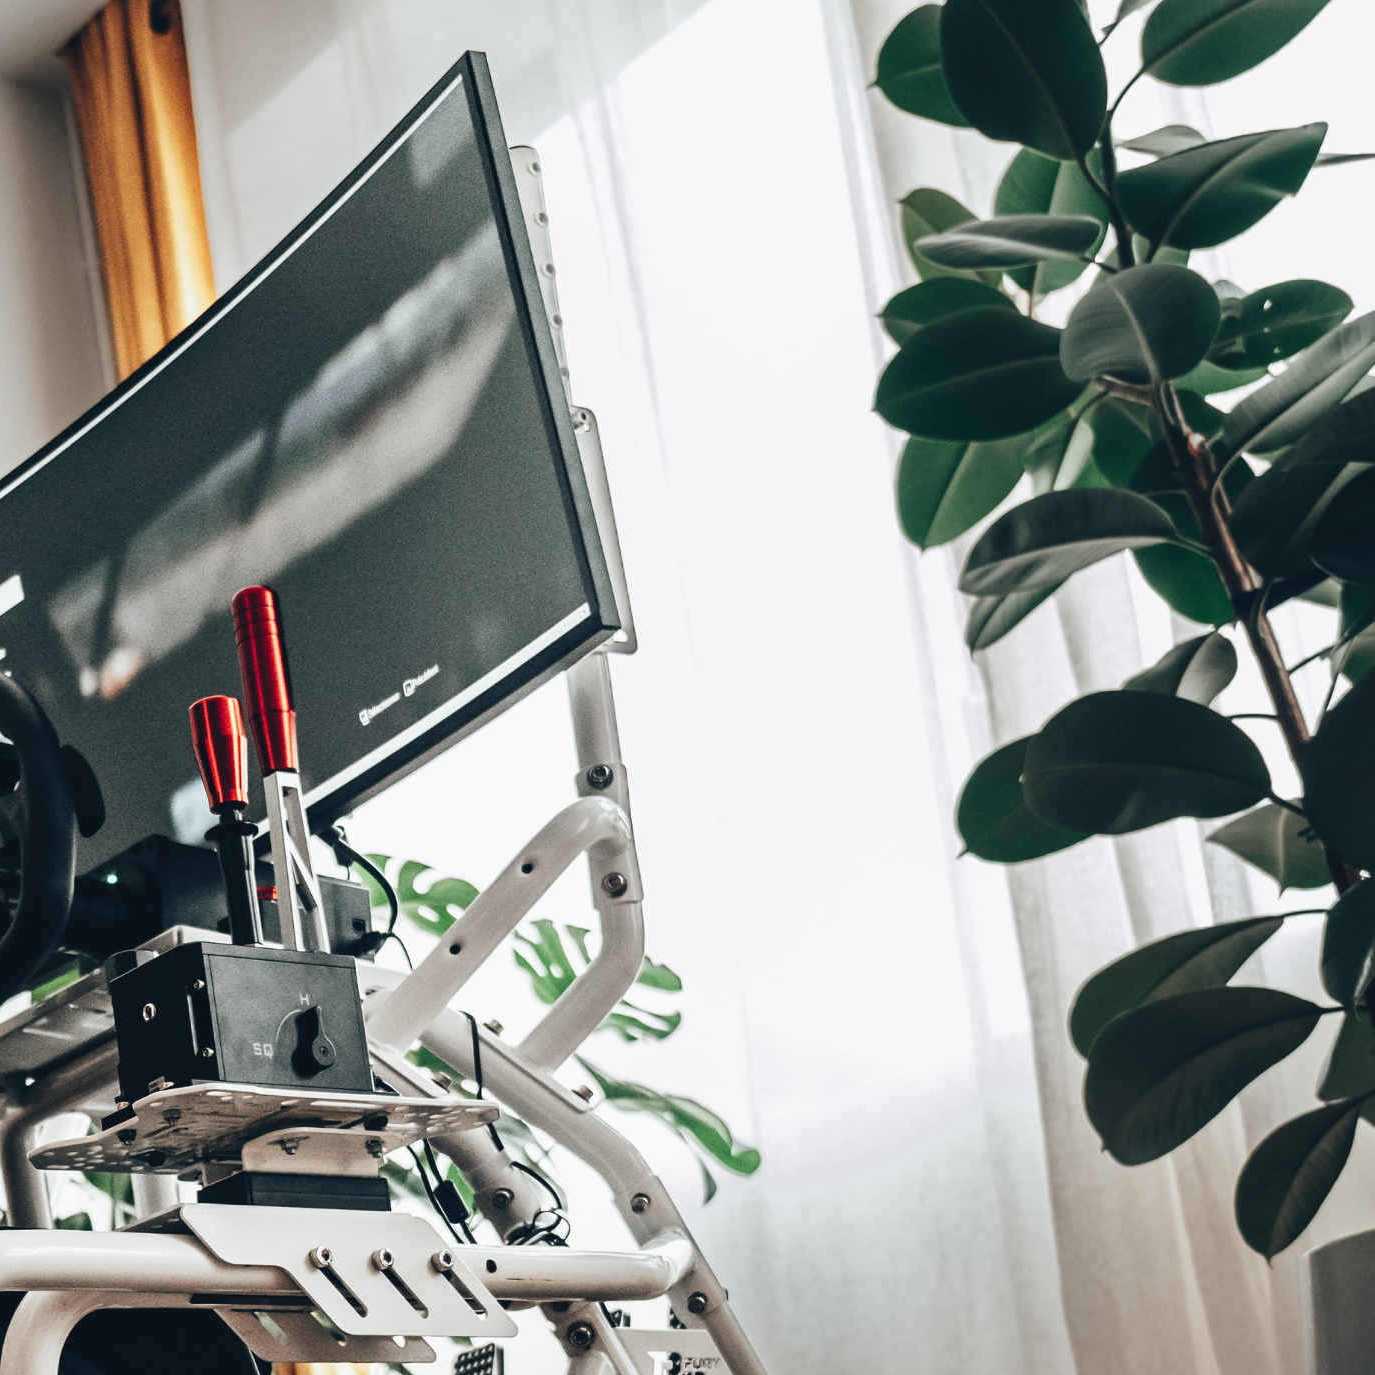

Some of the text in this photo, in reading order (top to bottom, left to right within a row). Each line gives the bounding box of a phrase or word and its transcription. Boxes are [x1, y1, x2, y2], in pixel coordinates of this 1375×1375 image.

[299, 993, 310, 1006] H
[252, 1042, 274, 1060] SQ
[684, 1356, 721, 1370] FURY
